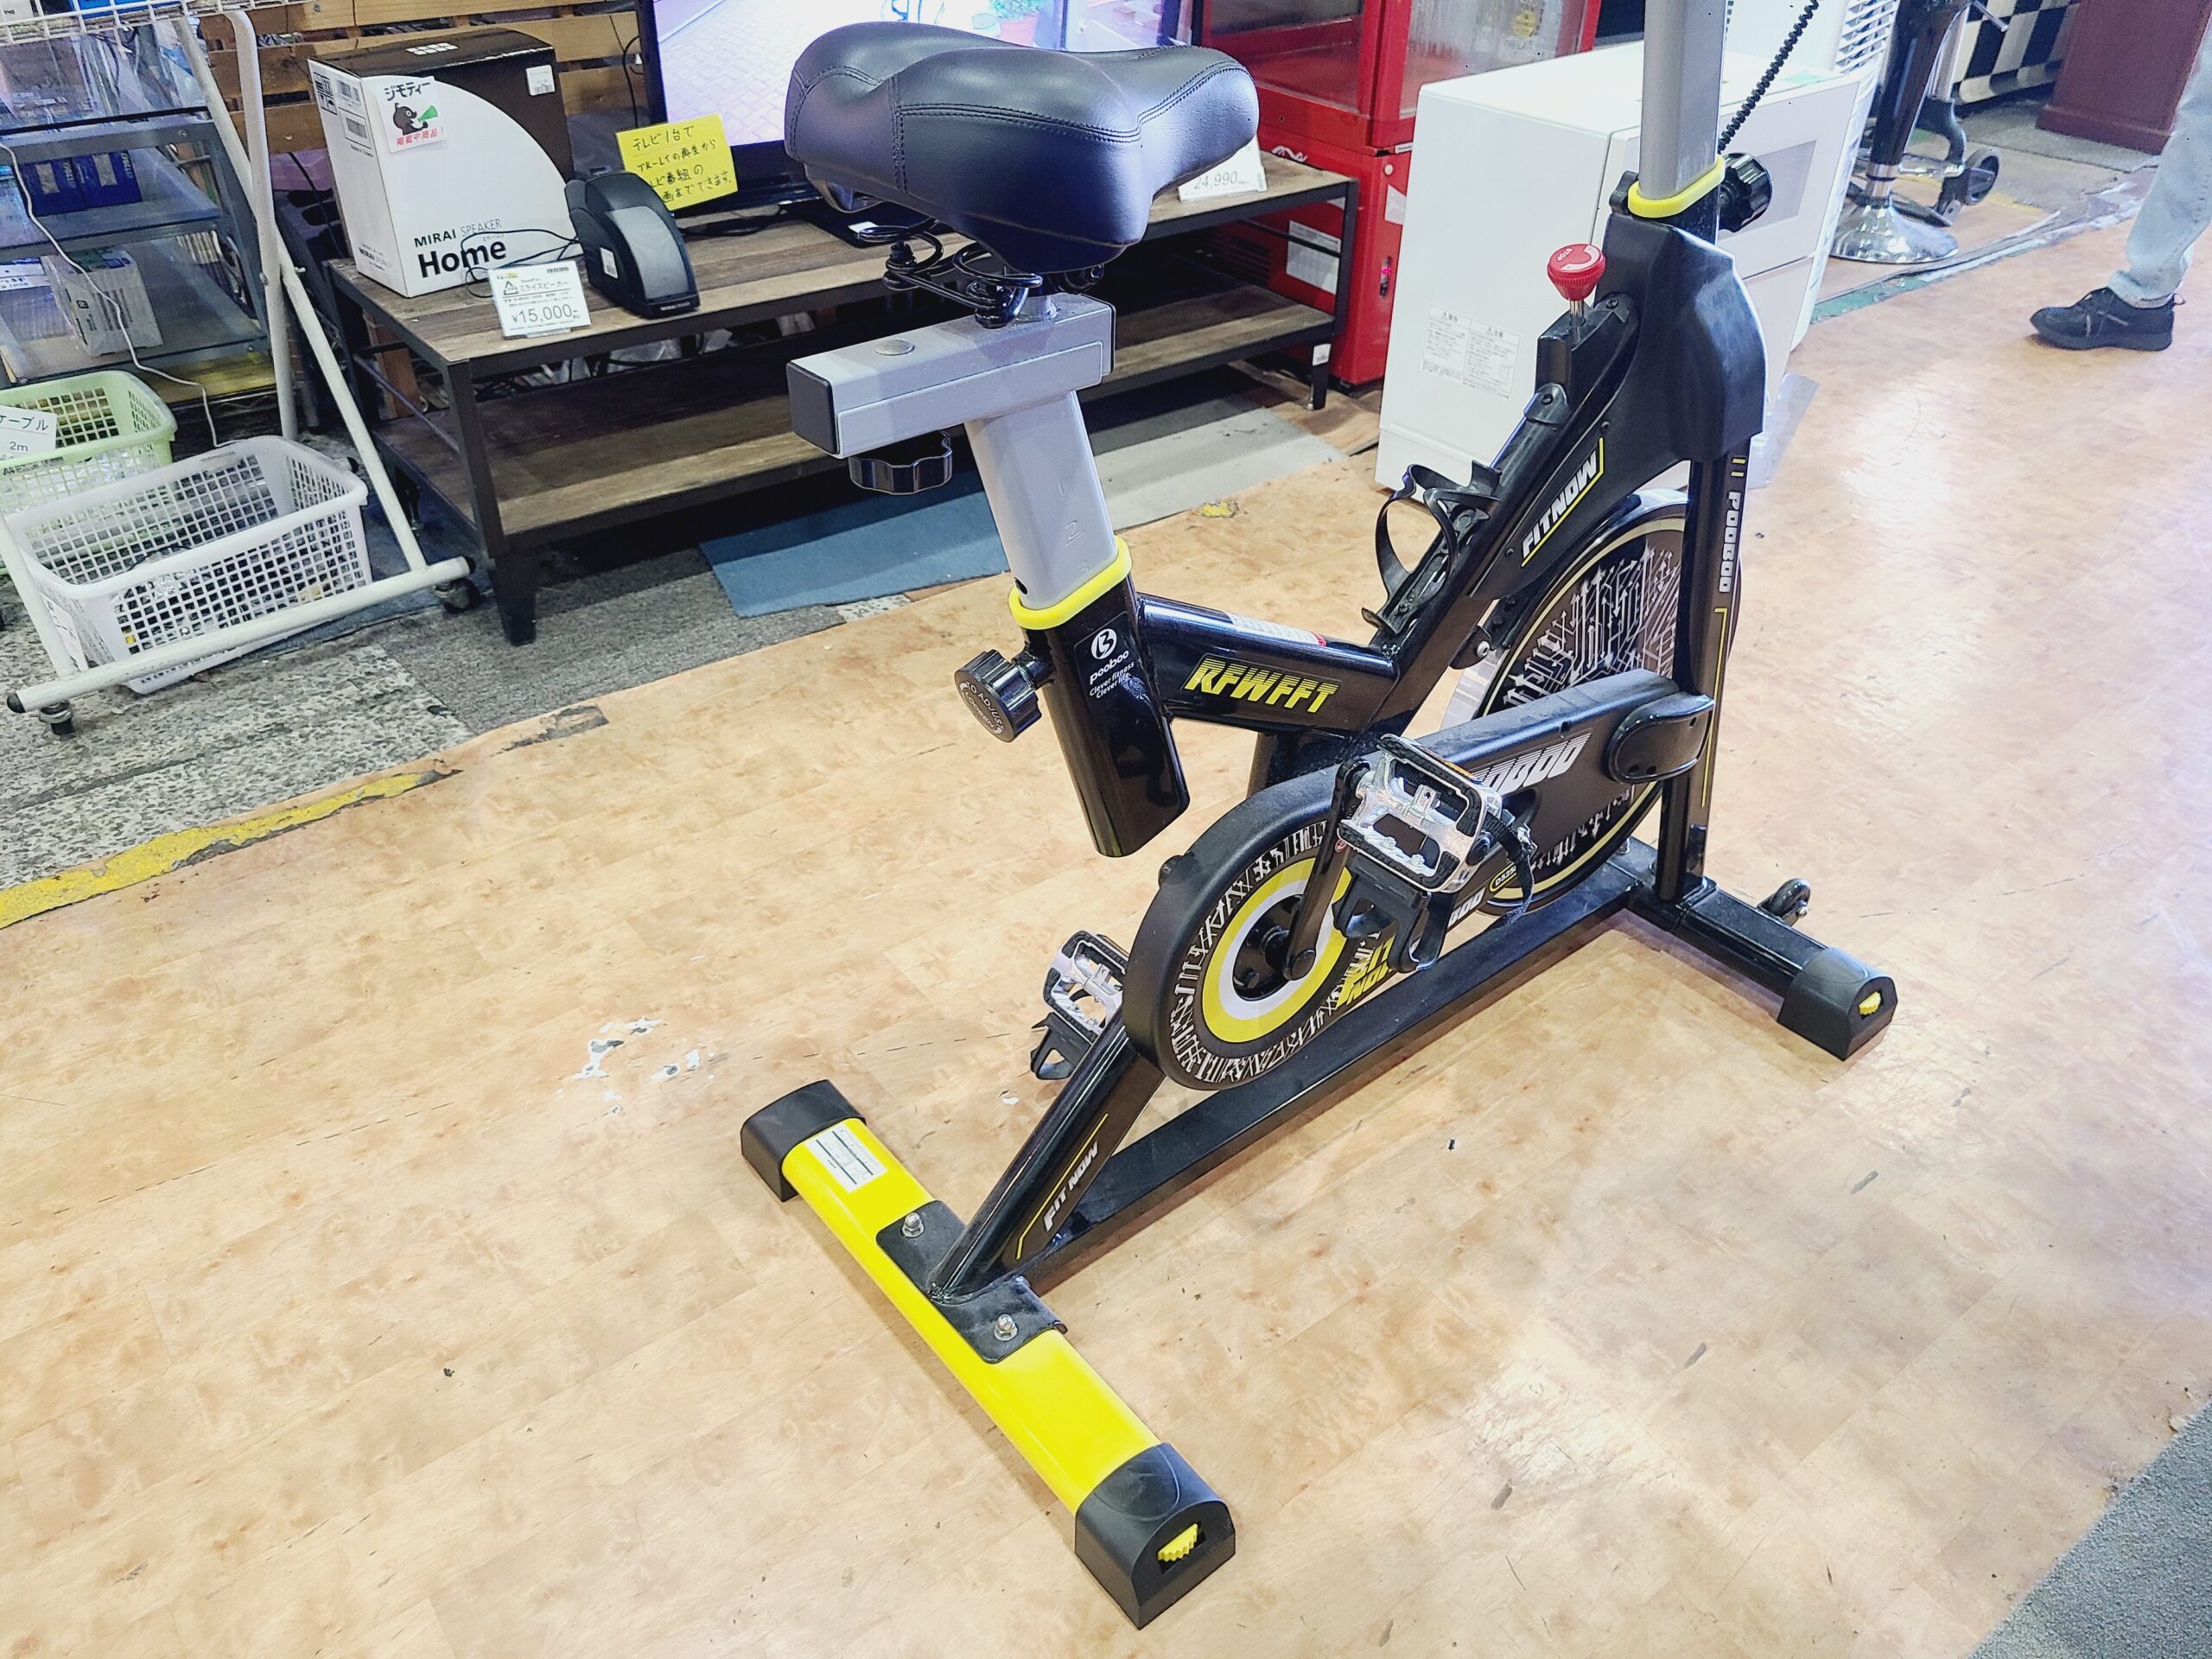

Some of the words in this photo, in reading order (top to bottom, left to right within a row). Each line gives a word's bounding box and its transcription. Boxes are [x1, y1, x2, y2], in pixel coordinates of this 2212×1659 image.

[384, 81, 431, 102] ジモティー
[1194, 170, 1237, 190] 24,990
[414, 229, 457, 248] MIRAI
[460, 218, 503, 238] SPEAKER
[417, 240, 507, 278] Home
[10, 441, 29, 452] 2m
[1719, 491, 1742, 593] POOBOO
[1090, 650, 1129, 685] pooboo
[1090, 677, 1112, 696] Clever
[1096, 680, 1118, 699] Clever
[965, 691, 995, 728] LOOSEN
[1043, 1186, 1067, 1232] FIT
[1067, 1141, 1098, 1192] NOW
